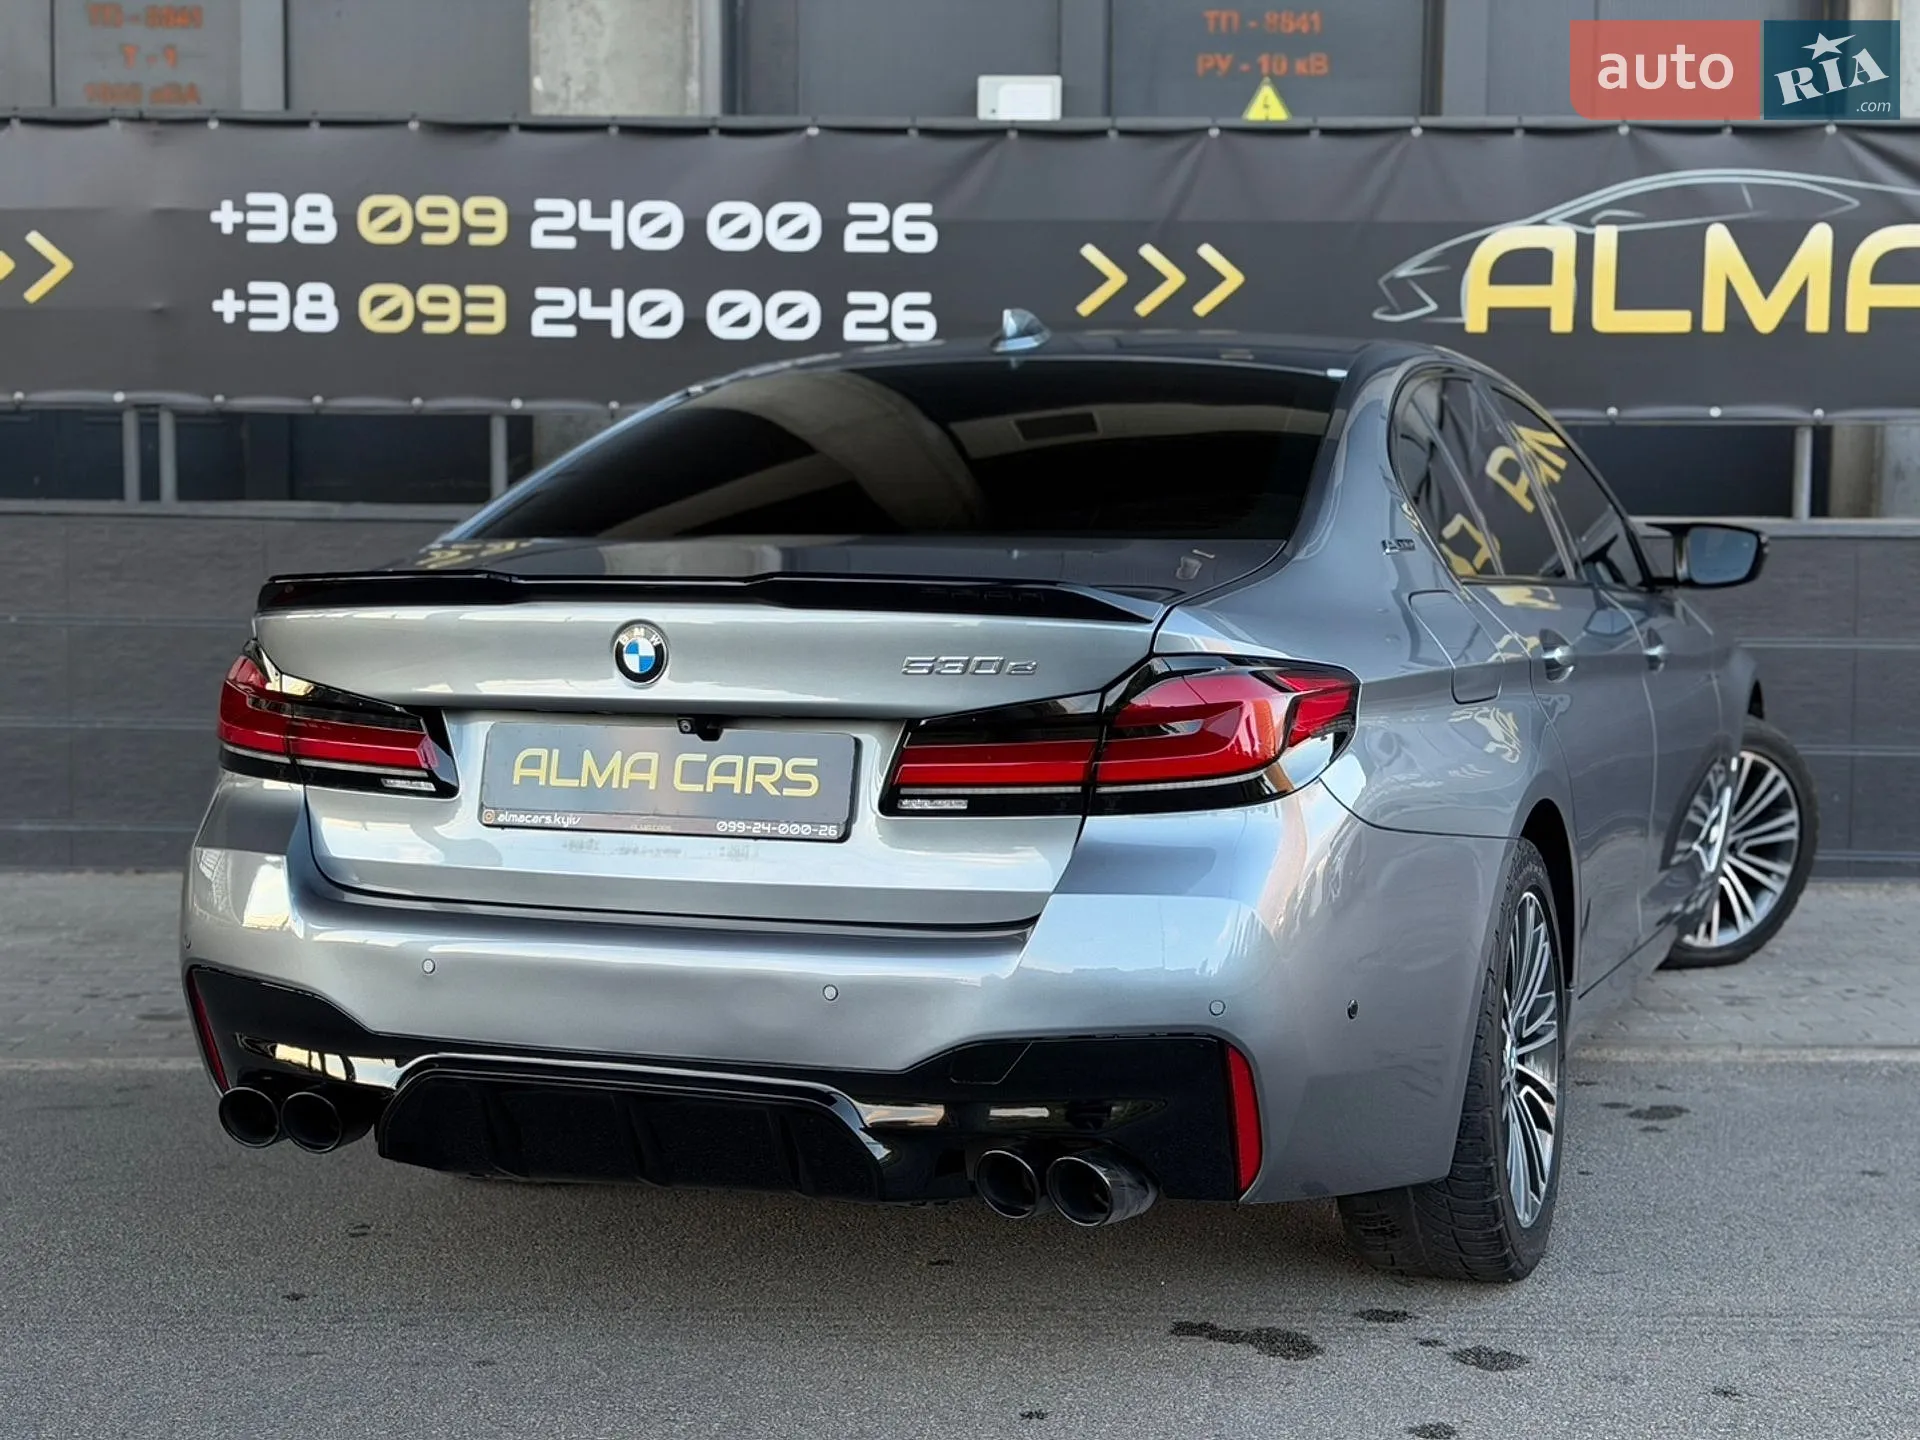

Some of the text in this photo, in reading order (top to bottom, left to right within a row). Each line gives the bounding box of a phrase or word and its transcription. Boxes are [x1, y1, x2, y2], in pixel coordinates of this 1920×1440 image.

[1203, 10, 1240, 34] ТП
[1197, 53, 1233, 77] РУ
[1257, 53, 1288, 76] 10
[210, 192, 938, 254] +38 099 240 00 26
[1464, 221, 1920, 334] ALMA
[212, 281, 938, 342] +38 093 240 00 26
[618, 627, 661, 646] BMW
[512, 747, 820, 798] ALMA CARS
[716, 820, 838, 837] 099-24-000-26
